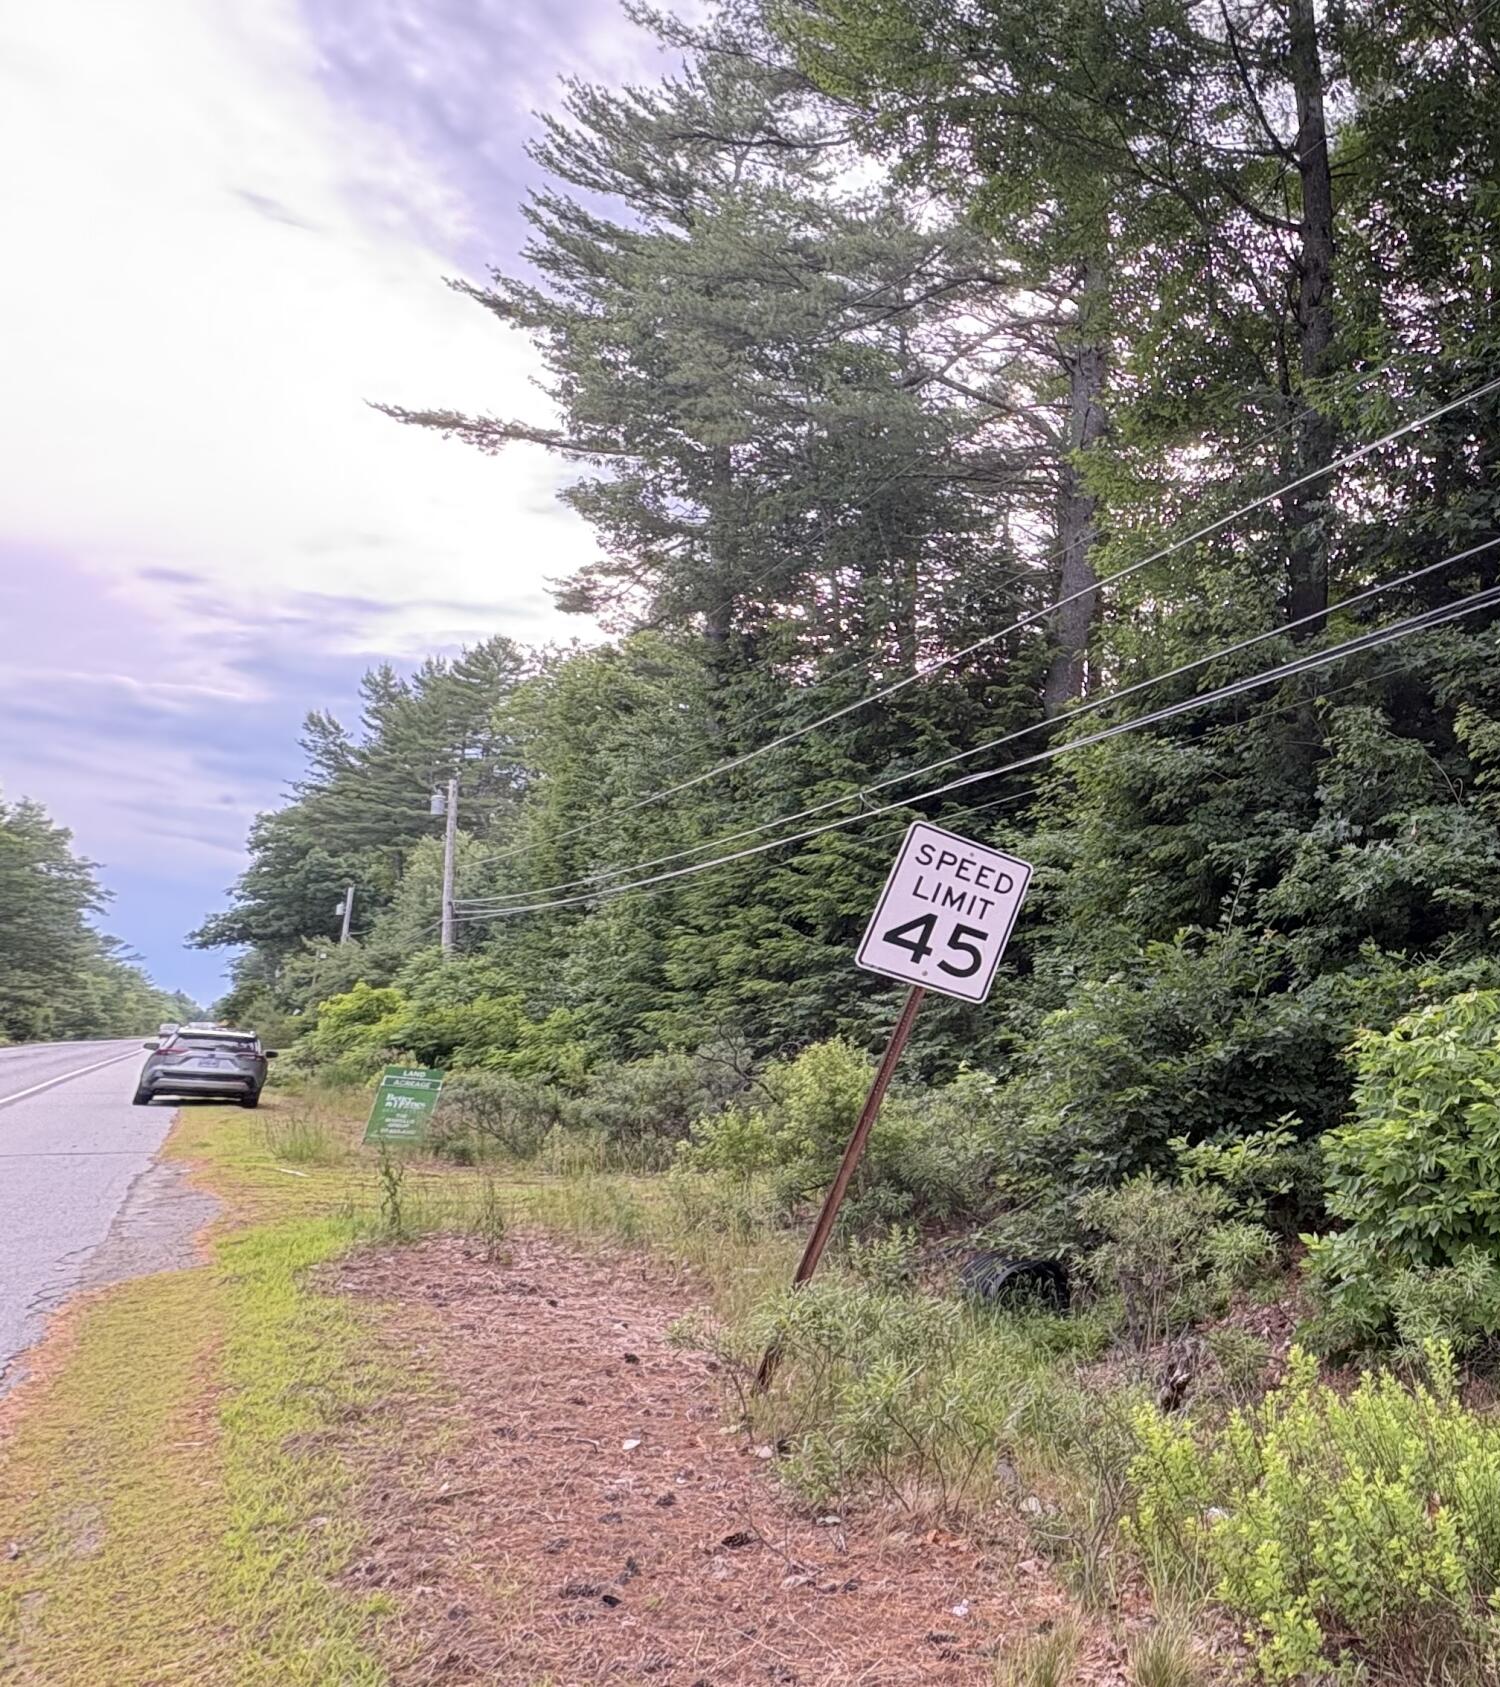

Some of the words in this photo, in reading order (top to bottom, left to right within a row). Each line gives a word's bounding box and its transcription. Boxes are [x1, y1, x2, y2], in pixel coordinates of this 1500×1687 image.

[915, 844, 1014, 894] SPEED
[912, 875, 995, 920] LIMIT
[882, 913, 989, 978] 45
[393, 1079, 432, 1089] ACREAGE
[402, 1070, 426, 1078] LAND
